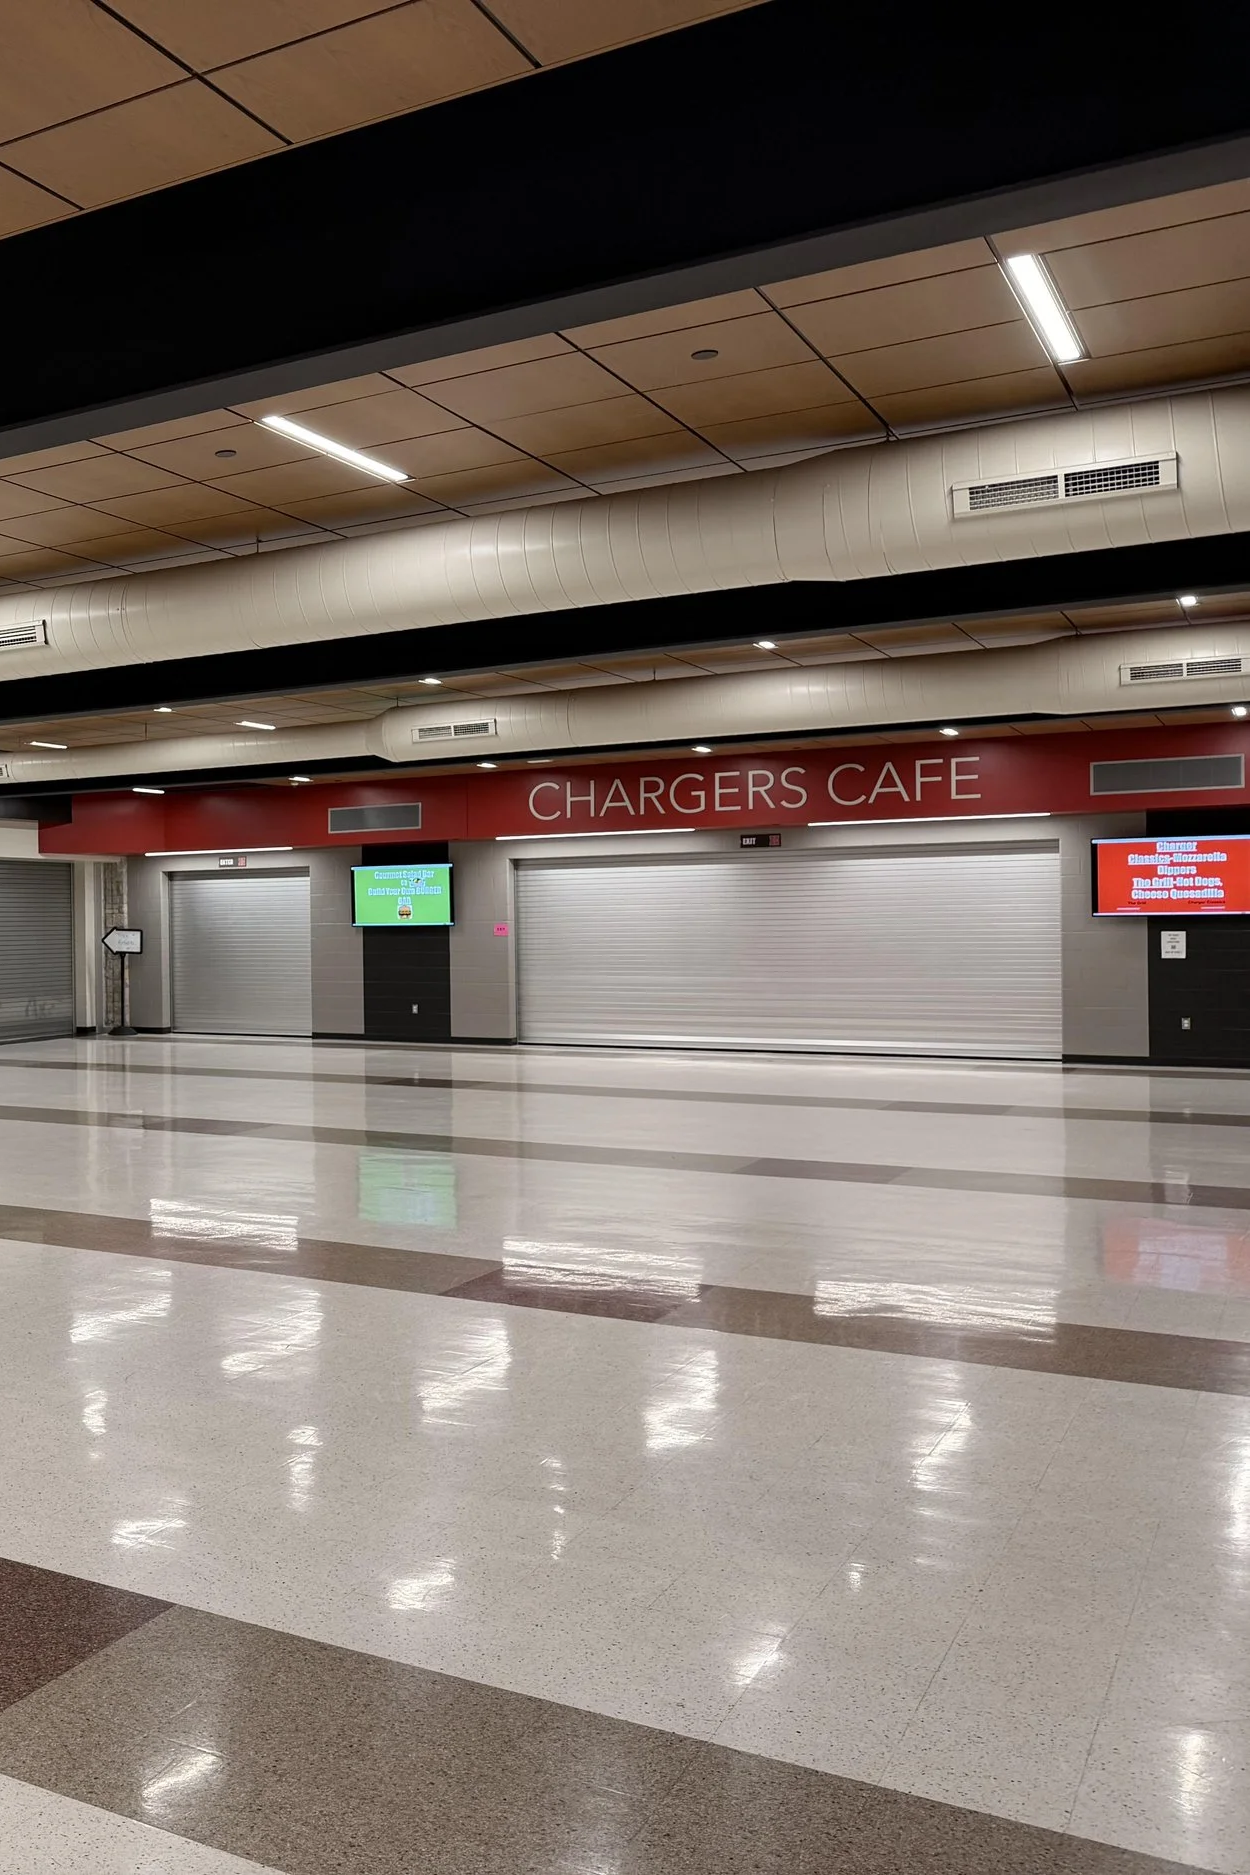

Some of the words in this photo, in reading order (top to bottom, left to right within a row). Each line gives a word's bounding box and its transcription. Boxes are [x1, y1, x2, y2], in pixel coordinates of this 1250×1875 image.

[528, 767, 808, 821] CHARGERS
[827, 756, 981, 806] CAFE
[742, 837, 756, 845] EXIT
[1156, 841, 1197, 852] Charger
[1132, 877, 1151, 888] The
